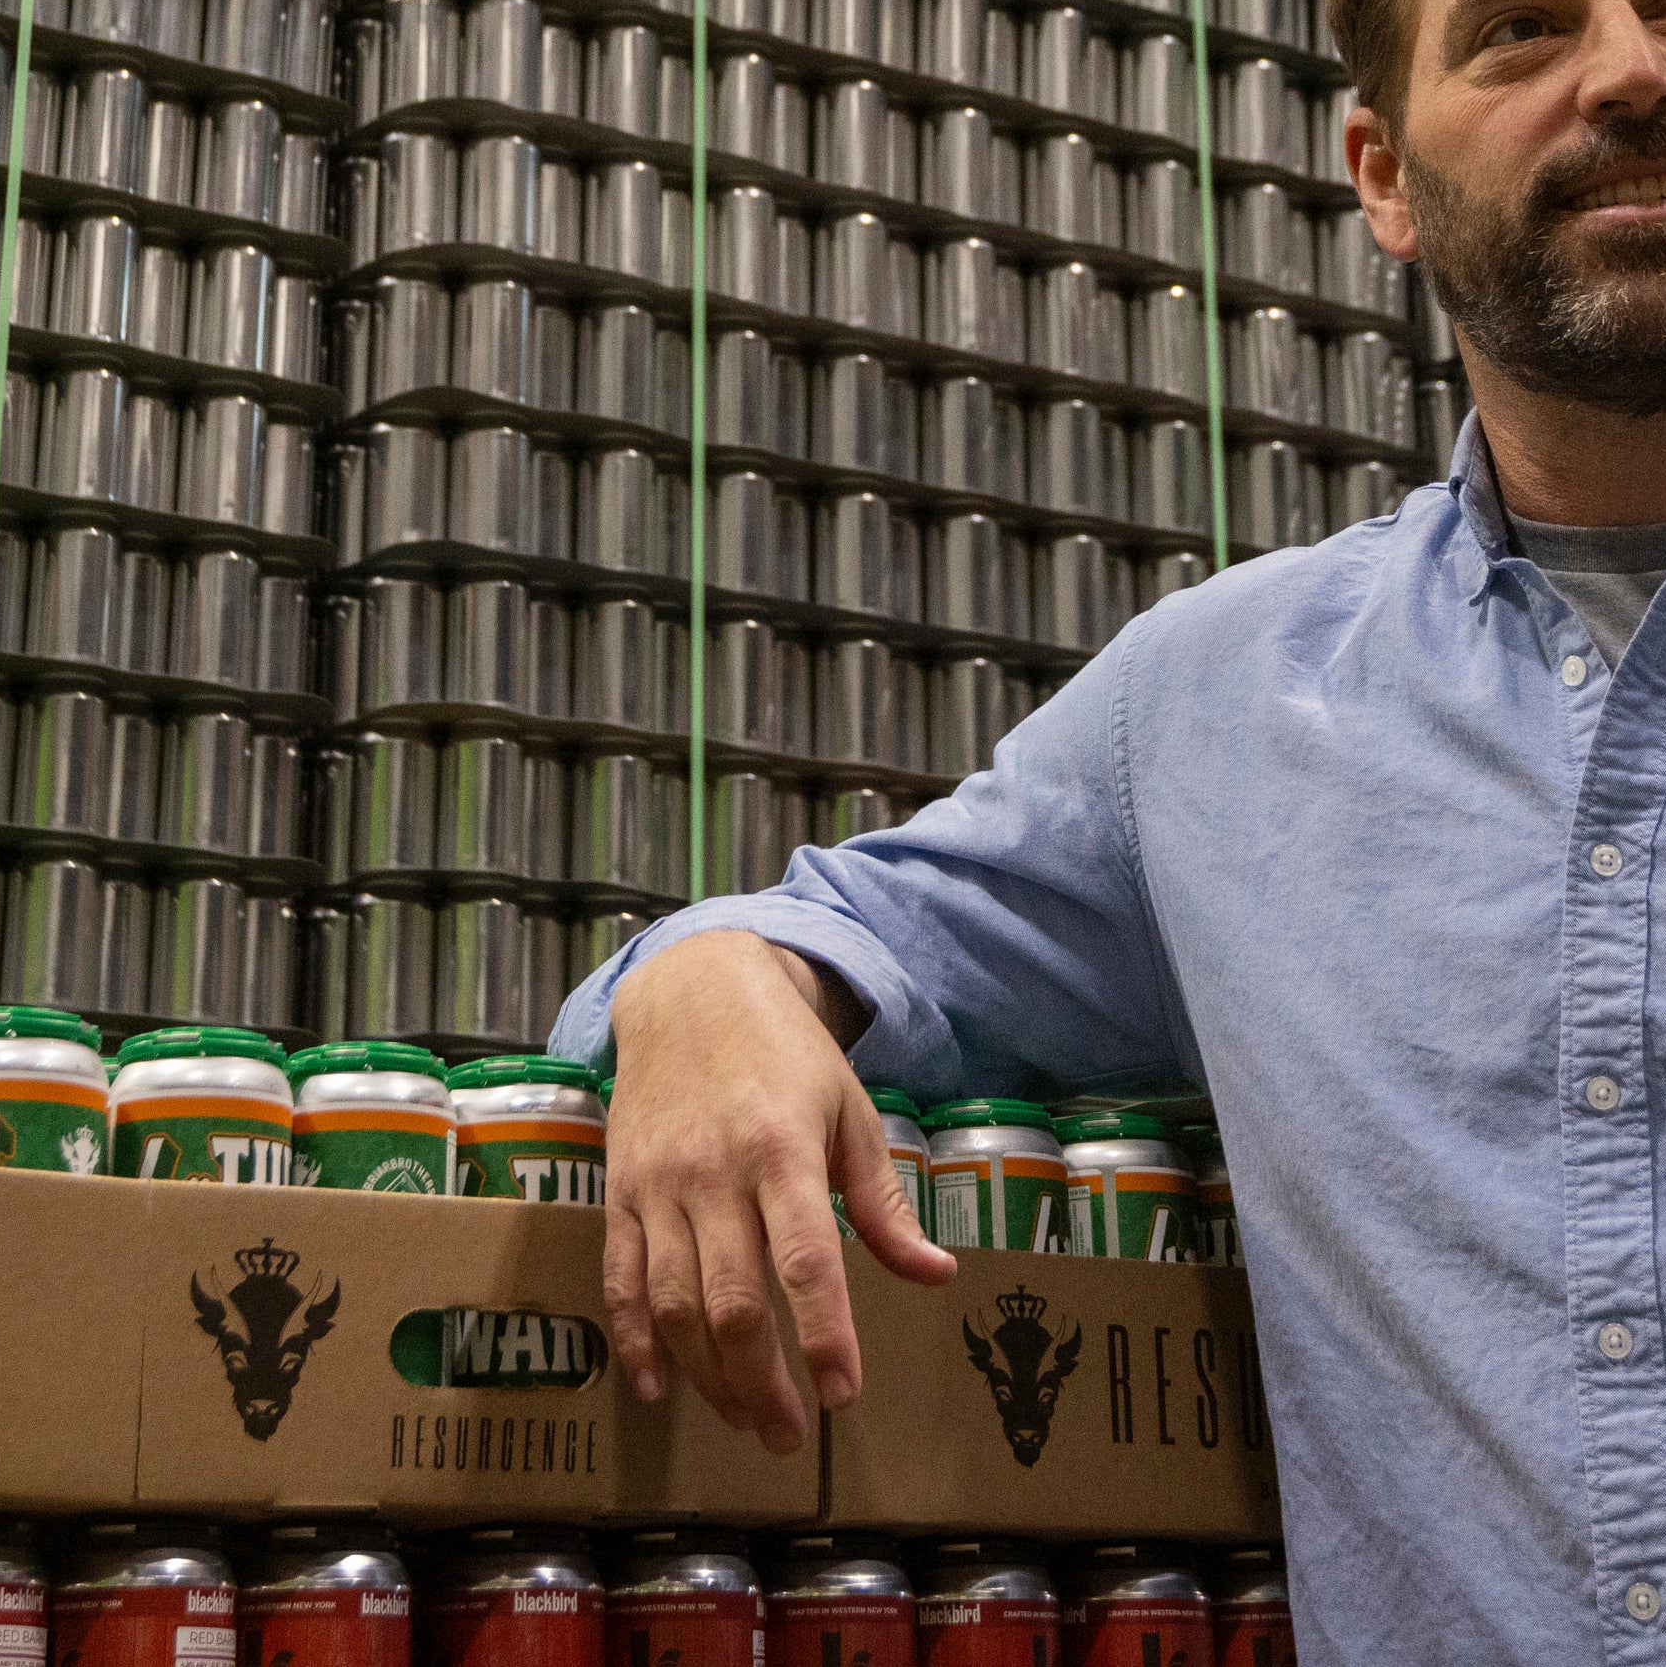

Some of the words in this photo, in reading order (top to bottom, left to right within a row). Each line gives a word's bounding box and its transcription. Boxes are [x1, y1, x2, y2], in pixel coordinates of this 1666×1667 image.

[391, 1414, 597, 1474] RESURGENCE
[315, 1601, 336, 1609] YORK
[361, 1592, 409, 1616] blackbird
[514, 1591, 578, 1613] blackbird
[640, 1604, 676, 1612] WESTERN
[698, 1602, 717, 1610] YORK
[831, 1606, 866, 1614] WESTERN
[867, 1606, 882, 1614] NEW
[919, 1603, 981, 1625] blackbird
[1003, 1610, 1032, 1618] CRAFTED
[189, 1631, 214, 1644] RED
